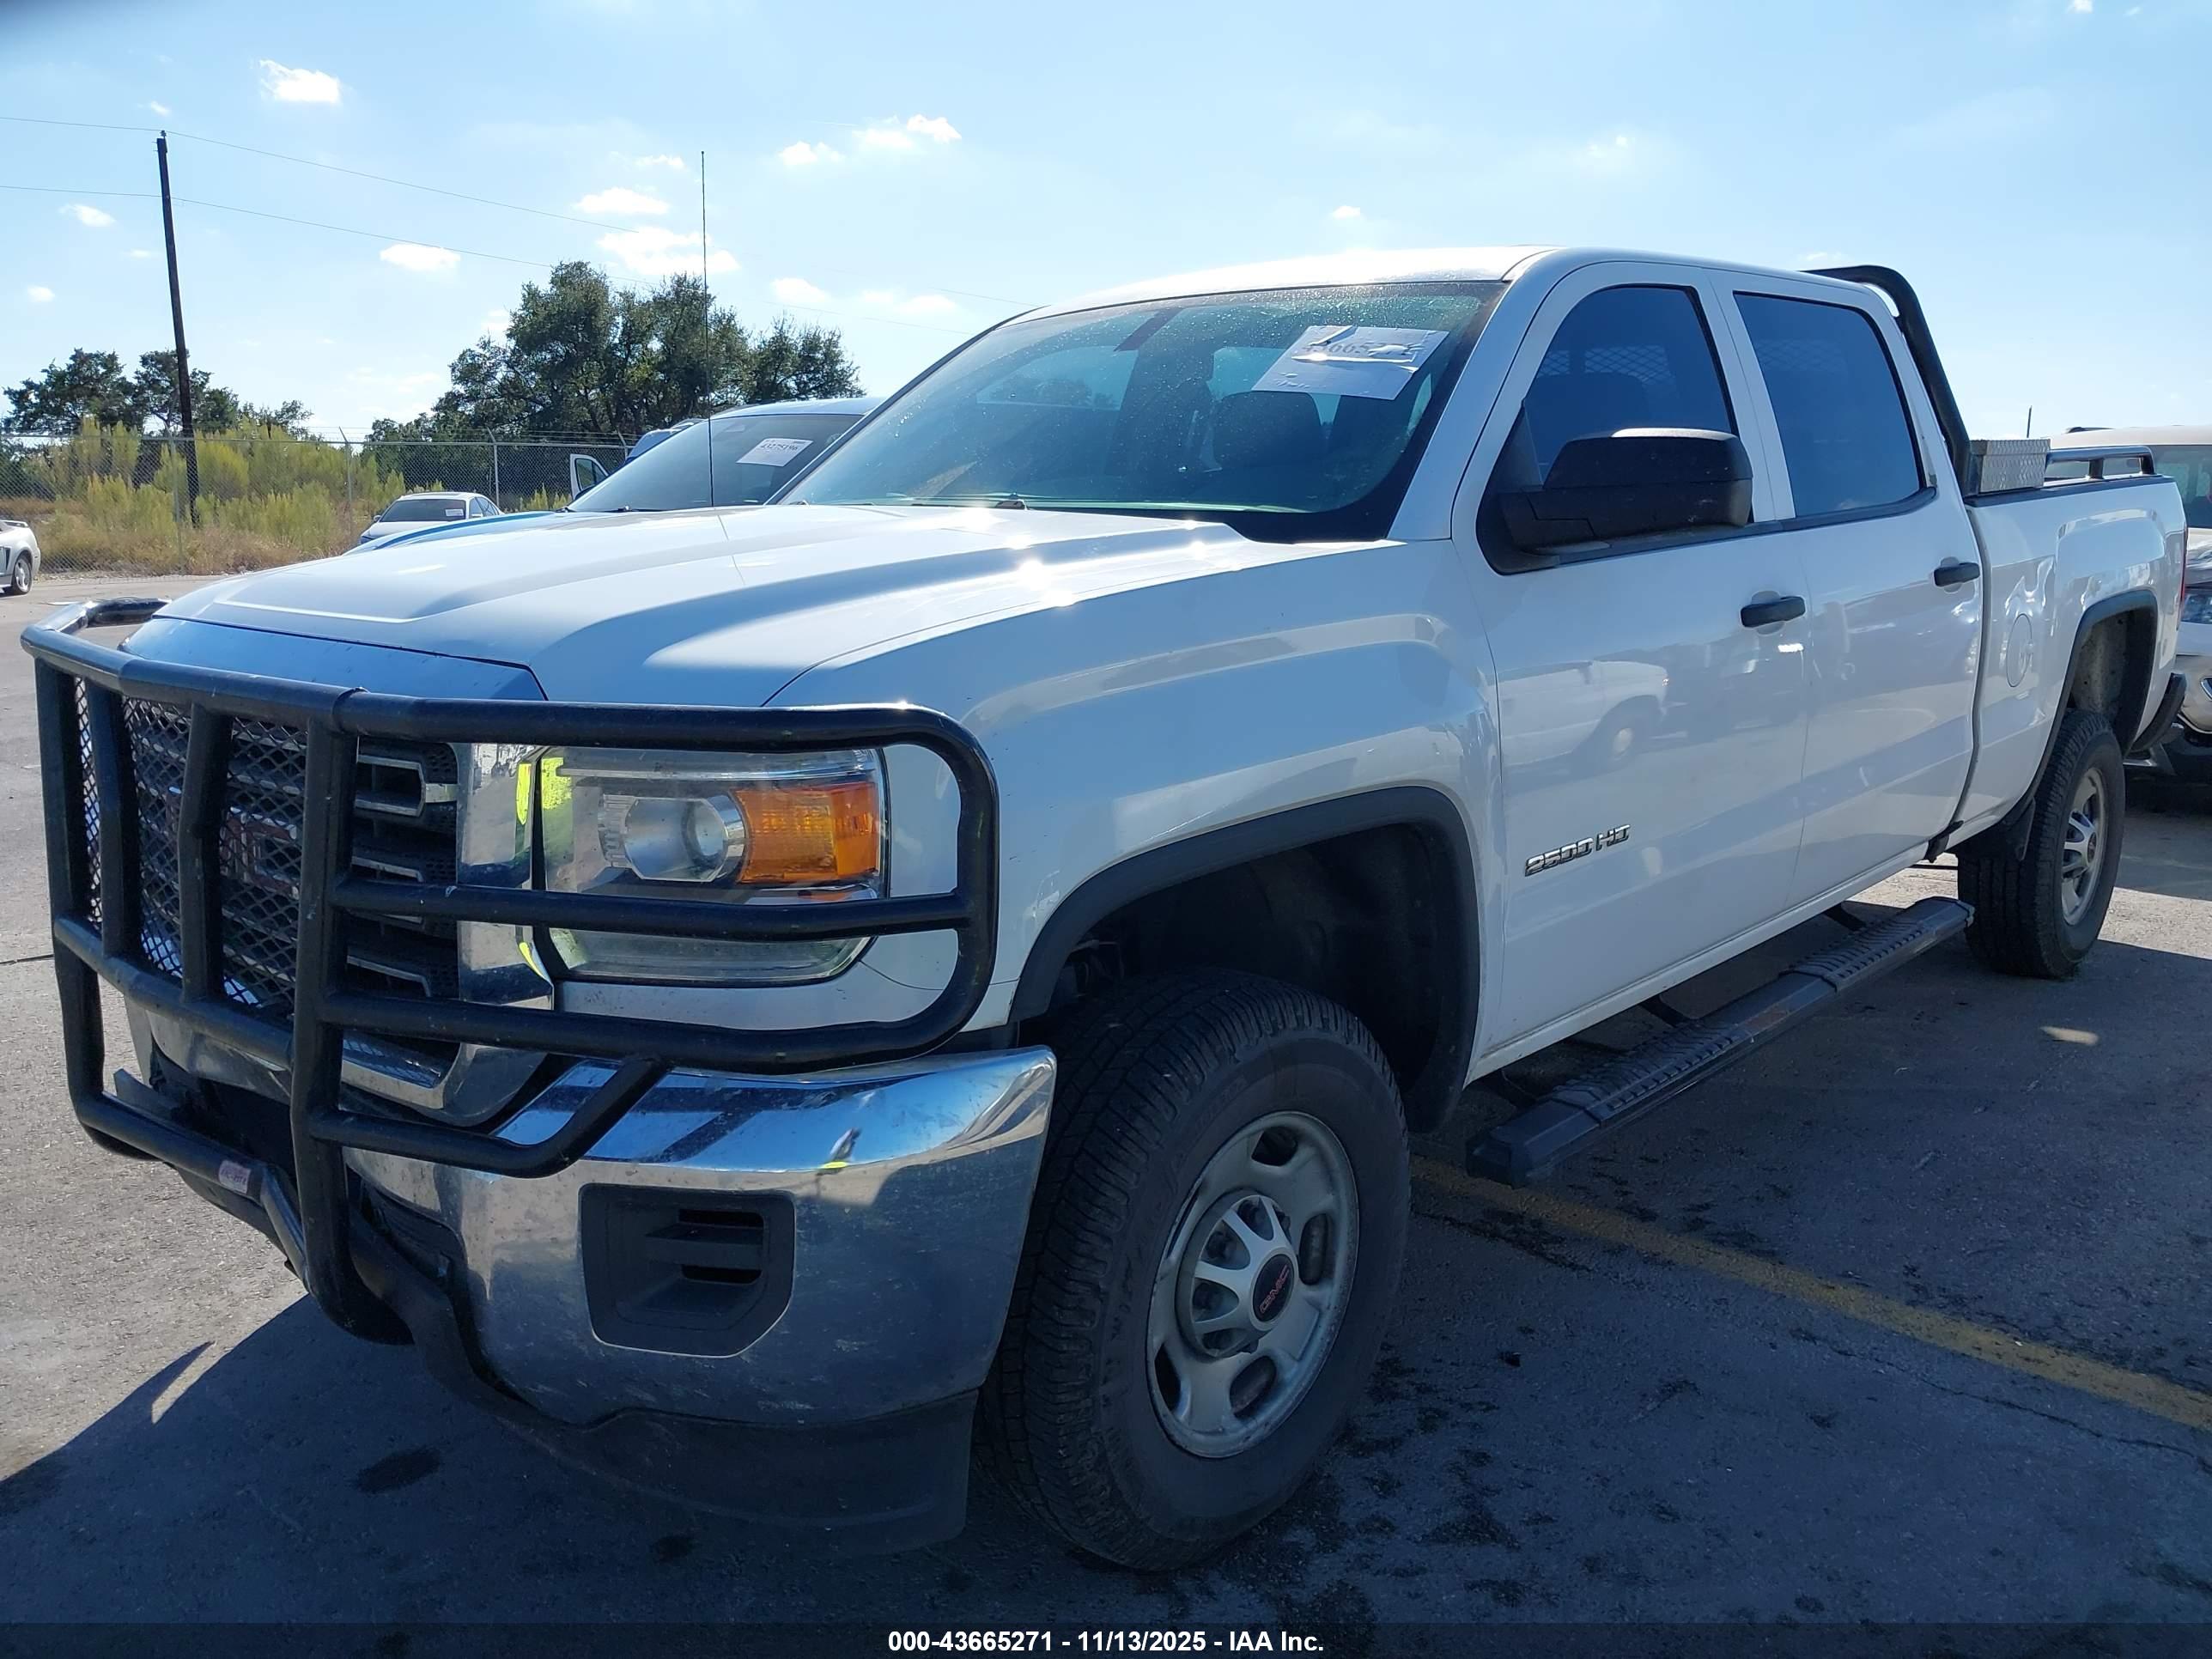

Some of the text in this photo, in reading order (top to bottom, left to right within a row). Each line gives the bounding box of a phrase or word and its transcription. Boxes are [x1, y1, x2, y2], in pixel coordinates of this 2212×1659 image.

[1525, 823, 1631, 878] 2500 HD
[1259, 1263, 1290, 1314] GMC
